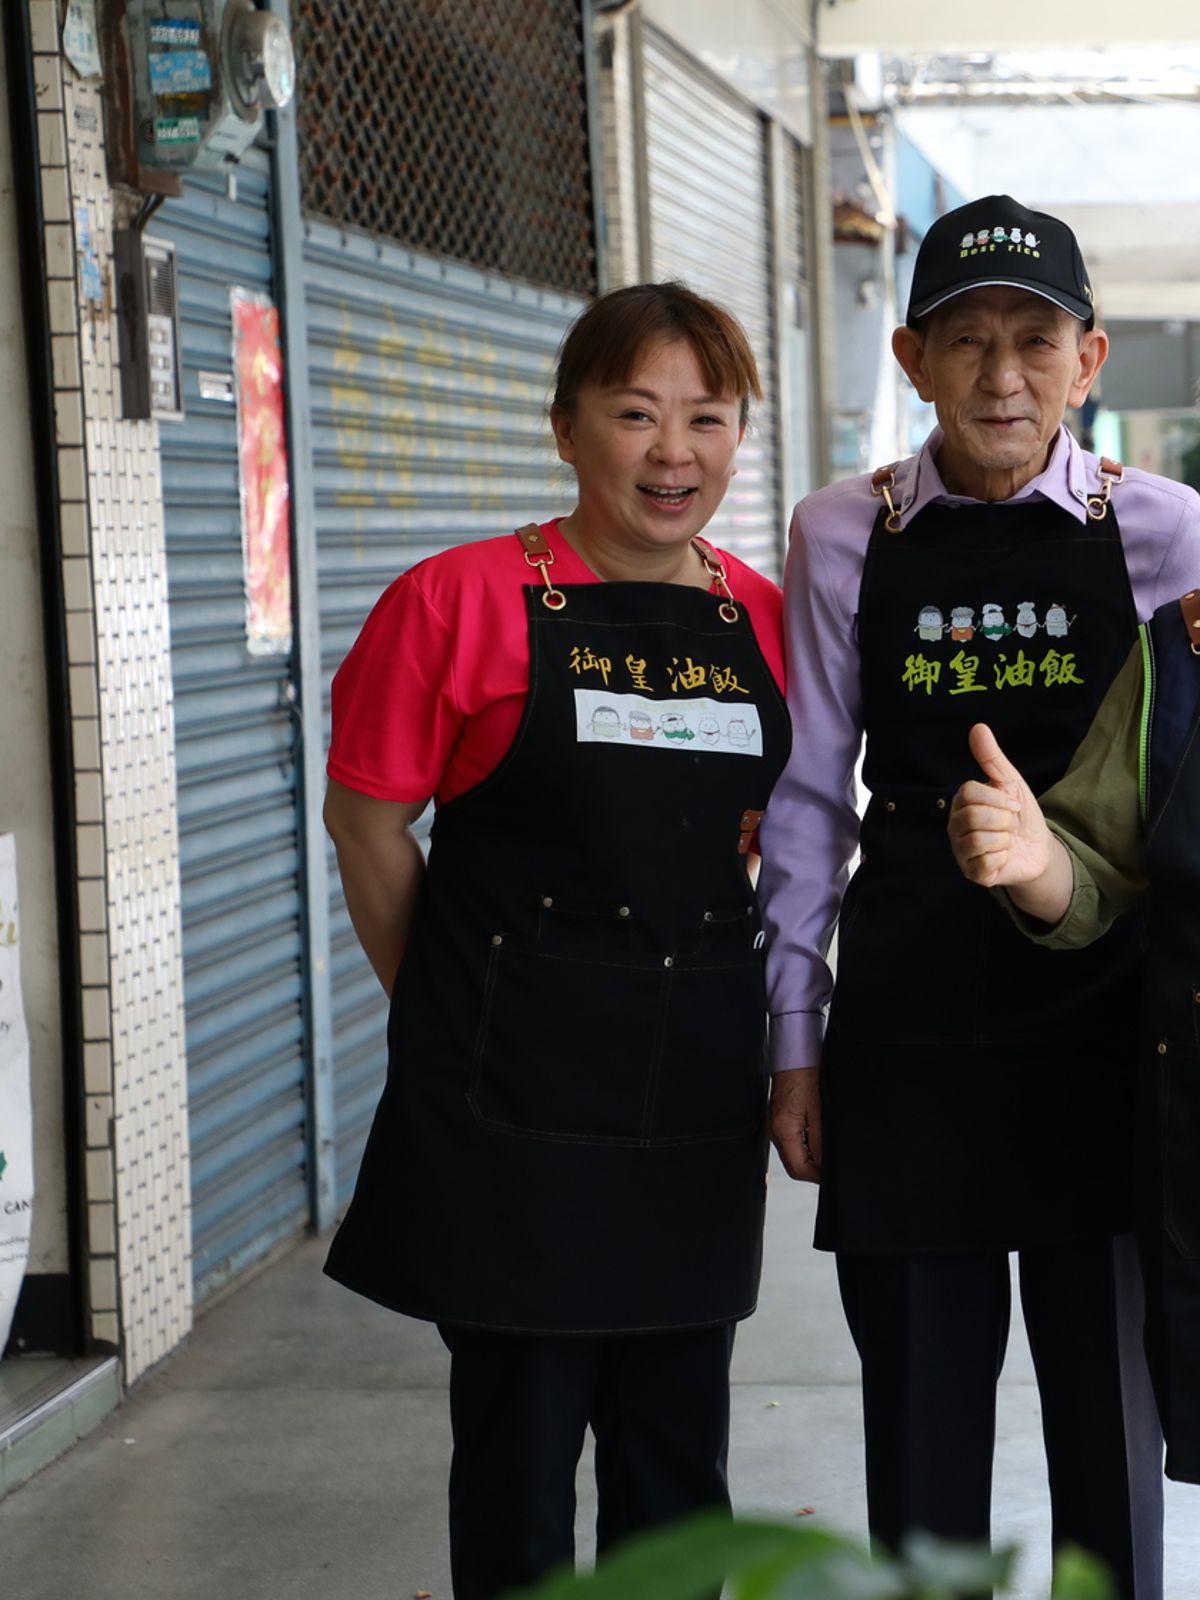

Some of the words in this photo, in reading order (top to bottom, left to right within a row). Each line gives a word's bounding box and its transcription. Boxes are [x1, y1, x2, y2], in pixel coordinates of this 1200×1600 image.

[960, 243, 997, 258] Best
[1007, 243, 1041, 259] rice
[567, 646, 751, 695] 御皇油飯
[901, 648, 1086, 696] 御皇油飯
